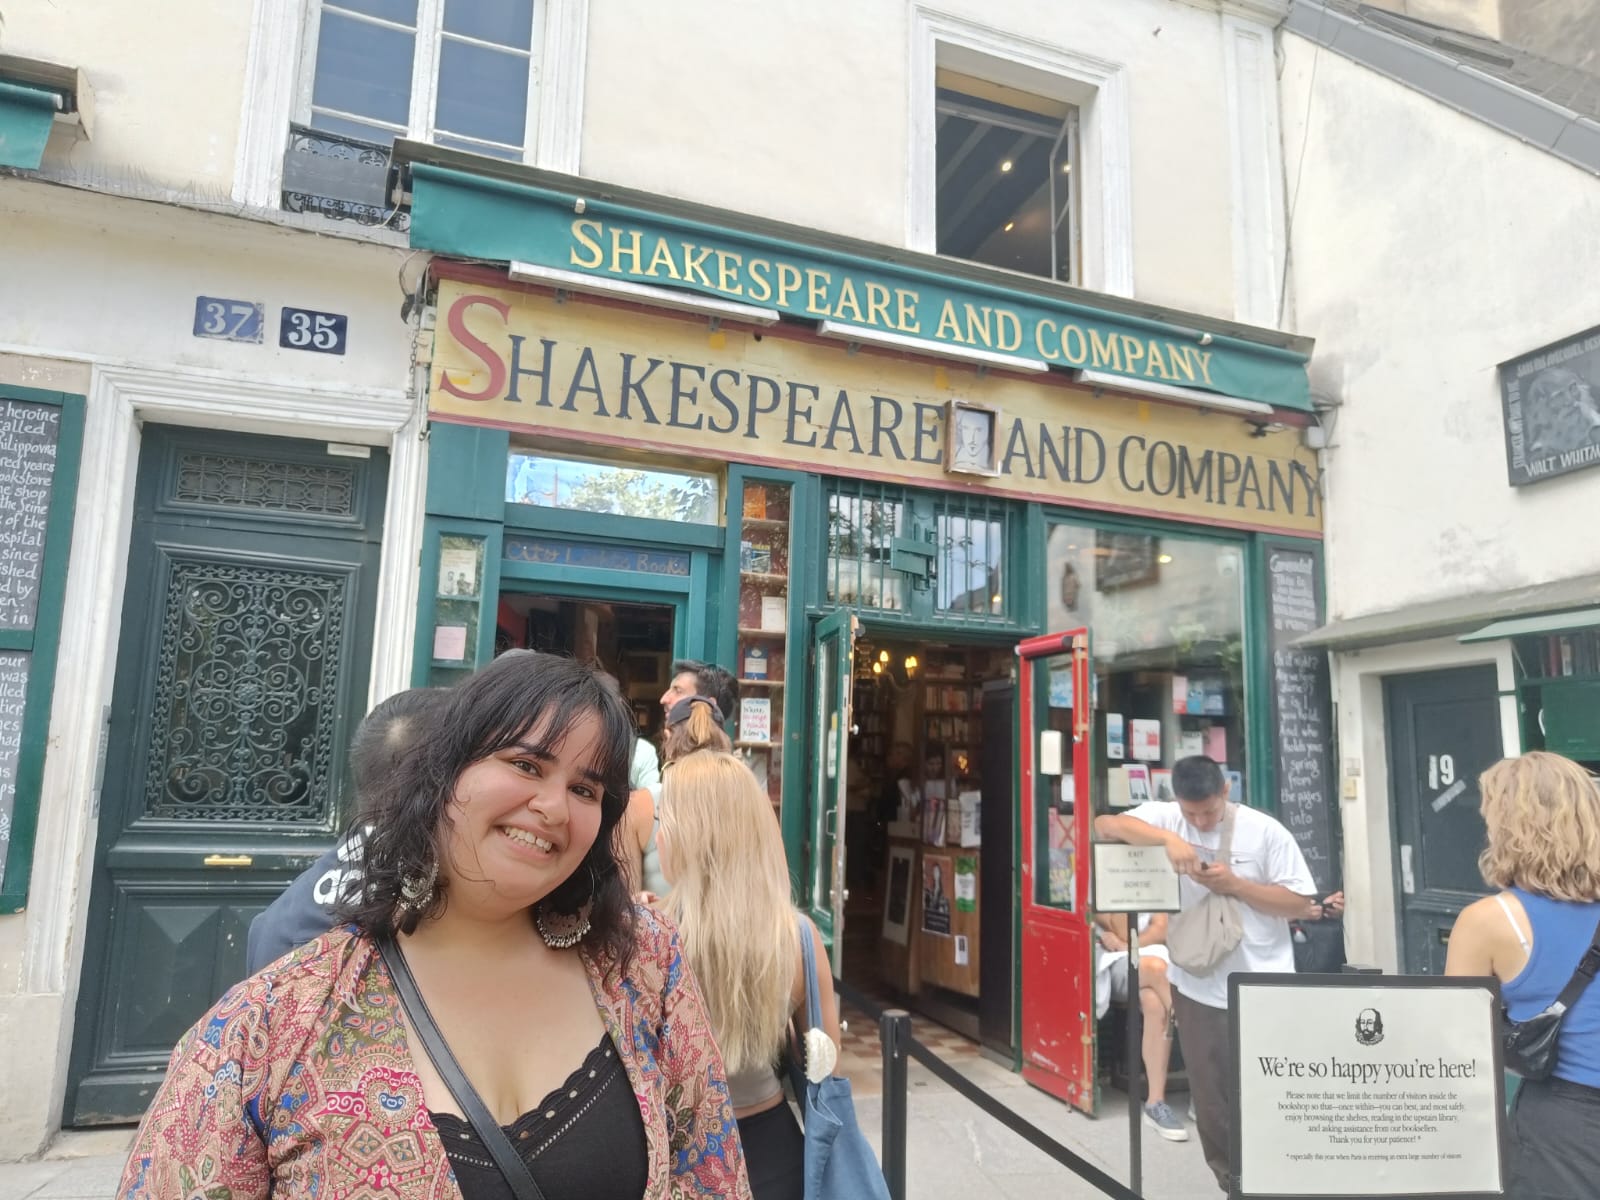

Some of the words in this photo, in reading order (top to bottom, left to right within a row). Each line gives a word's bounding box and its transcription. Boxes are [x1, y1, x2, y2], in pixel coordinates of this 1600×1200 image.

[570, 219, 921, 334] SHAKESPEARE
[935, 299, 1022, 352] AND
[1036, 318, 1213, 385] COMPANY
[204, 302, 254, 336] 37
[288, 313, 338, 349] 35
[7, 401, 60, 424] heroine
[439, 293, 944, 464] SHAKESPEARE
[1001, 417, 1106, 484] AND
[1117, 434, 1325, 518] COMPANY
[24, 461, 55, 477] years
[1524, 456, 1557, 477] WALT
[14, 485, 47, 505] shop
[5, 512, 23, 530] of
[23, 515, 47, 530] the
[2, 547, 39, 562] since
[17, 580, 35, 600] by
[13, 609, 29, 625] in
[1429, 754, 1454, 789] 19
[1257, 1056, 1305, 1077] We're
[1308, 1062, 1327, 1077] so
[1331, 1057, 1382, 1084] happy
[1384, 1058, 1435, 1084] you're
[1438, 1057, 1477, 1078] here!
[1286, 1091, 1305, 1099] Please
[1307, 1091, 1320, 1099] note
[1322, 1091, 1334, 1099] that
[1347, 1091, 1360, 1099] limit
[1362, 1091, 1372, 1099] the
[1373, 1091, 1397, 1099] number
[1399, 1091, 1406, 1099] of
[1429, 1091, 1446, 1099] inside
[1448, 1091, 1458, 1099] the
[1278, 1101, 1310, 1112] bookshop
[1420, 1102, 1431, 1110] and
[1285, 1113, 1302, 1124] enjoy
[1303, 1113, 1334, 1123] browsing
[1335, 1113, 1345, 1121] the
[1371, 1113, 1394, 1123] reading
[1395, 1113, 1401, 1121] in
[1402, 1113, 1412, 1121] the
[1414, 1114, 1437, 1123] upstairs
[1308, 1124, 1320, 1132] and
[1321, 1124, 1343, 1134] asking
[1344, 1124, 1374, 1132] assistance
[1375, 1124, 1389, 1132] from
[1329, 1135, 1349, 1143] Thank
[1351, 1137, 1362, 1146] you
[1363, 1135, 1372, 1143] for
[1373, 1137, 1387, 1146] your
